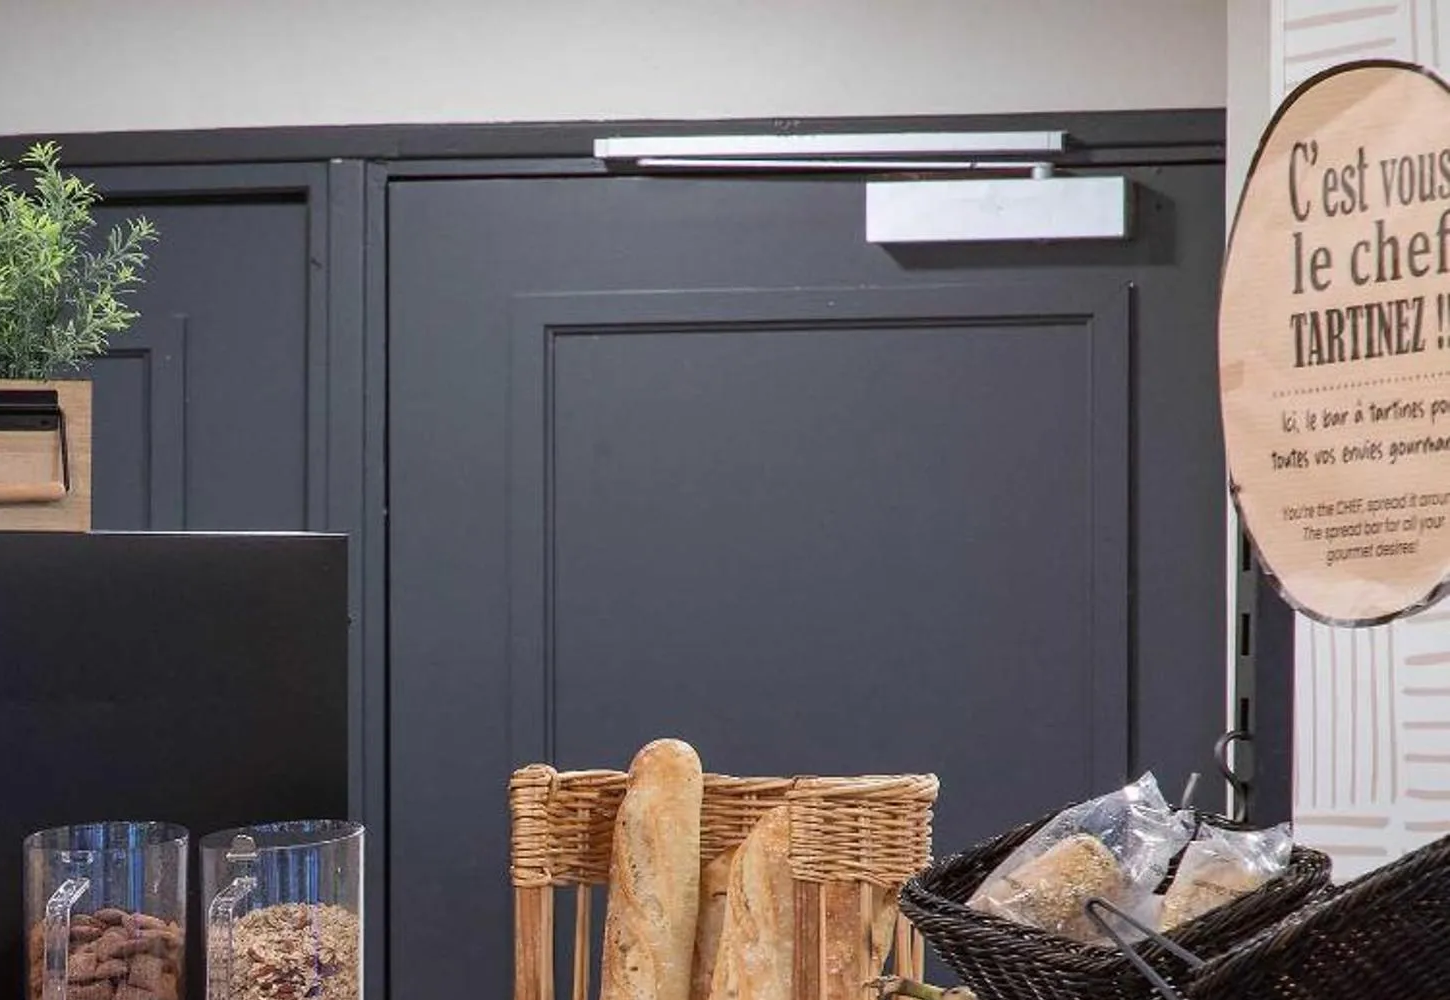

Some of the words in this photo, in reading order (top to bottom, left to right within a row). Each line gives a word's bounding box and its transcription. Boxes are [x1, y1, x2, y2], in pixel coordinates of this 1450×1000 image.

[1288, 140, 1369, 222] C'est
[1292, 231, 1332, 295] le
[1350, 208, 1450, 287] chef
[1290, 296, 1426, 368] TARTINEZ
[1306, 409, 1317, 431] le
[1323, 408, 1349, 429] bar
[1369, 399, 1425, 422] tartines
[1271, 448, 1309, 470] toutes
[1314, 448, 1336, 465] vos
[1342, 439, 1383, 464] envies
[1317, 503, 1334, 517] the
[1367, 495, 1406, 516] spread
[1303, 526, 1322, 541] The
[1325, 523, 1361, 544] spread
[1364, 522, 1382, 536] bar
[1419, 515, 1446, 535] your
[1326, 545, 1373, 567] gourmet
